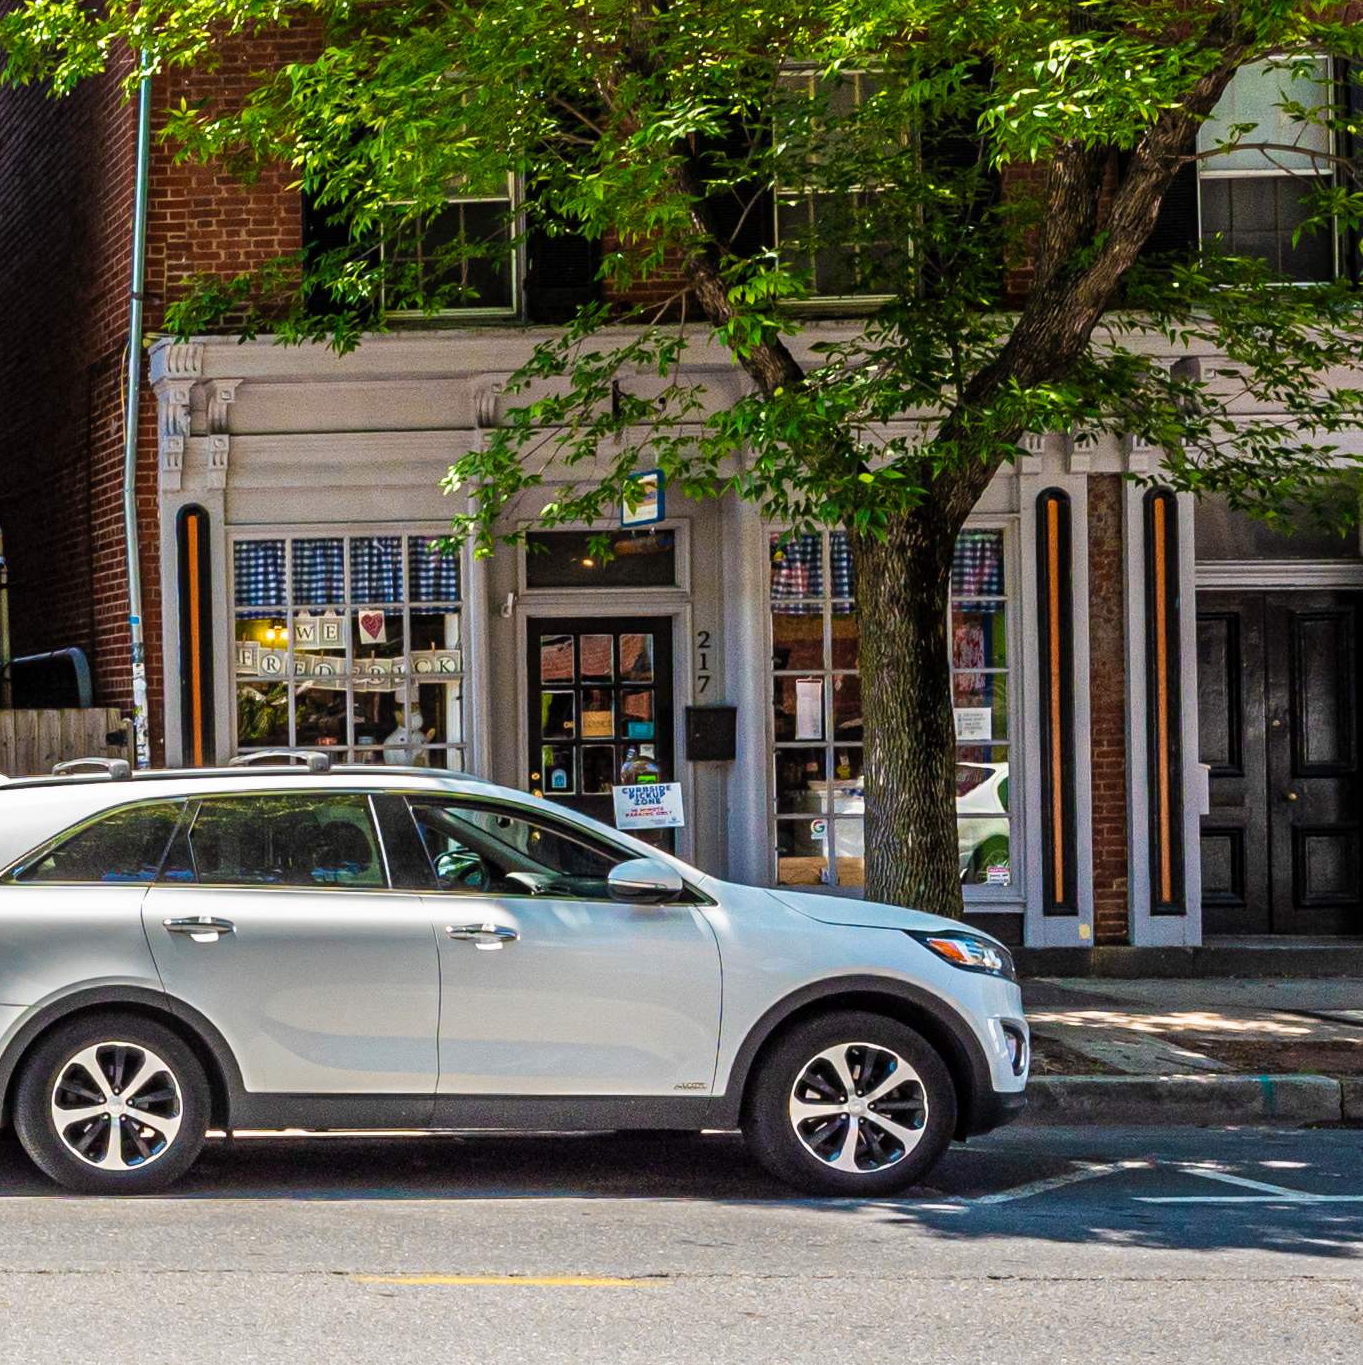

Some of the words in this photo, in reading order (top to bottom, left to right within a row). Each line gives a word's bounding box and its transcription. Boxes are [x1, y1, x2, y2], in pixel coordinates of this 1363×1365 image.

[296, 625, 338, 641] WE
[241, 648, 453, 681] FREDRICK
[697, 631, 711, 693] 217
[621, 785, 672, 794] CURBSIDE
[629, 791, 666, 800] PICKUP
[634, 797, 662, 805] ZONE
